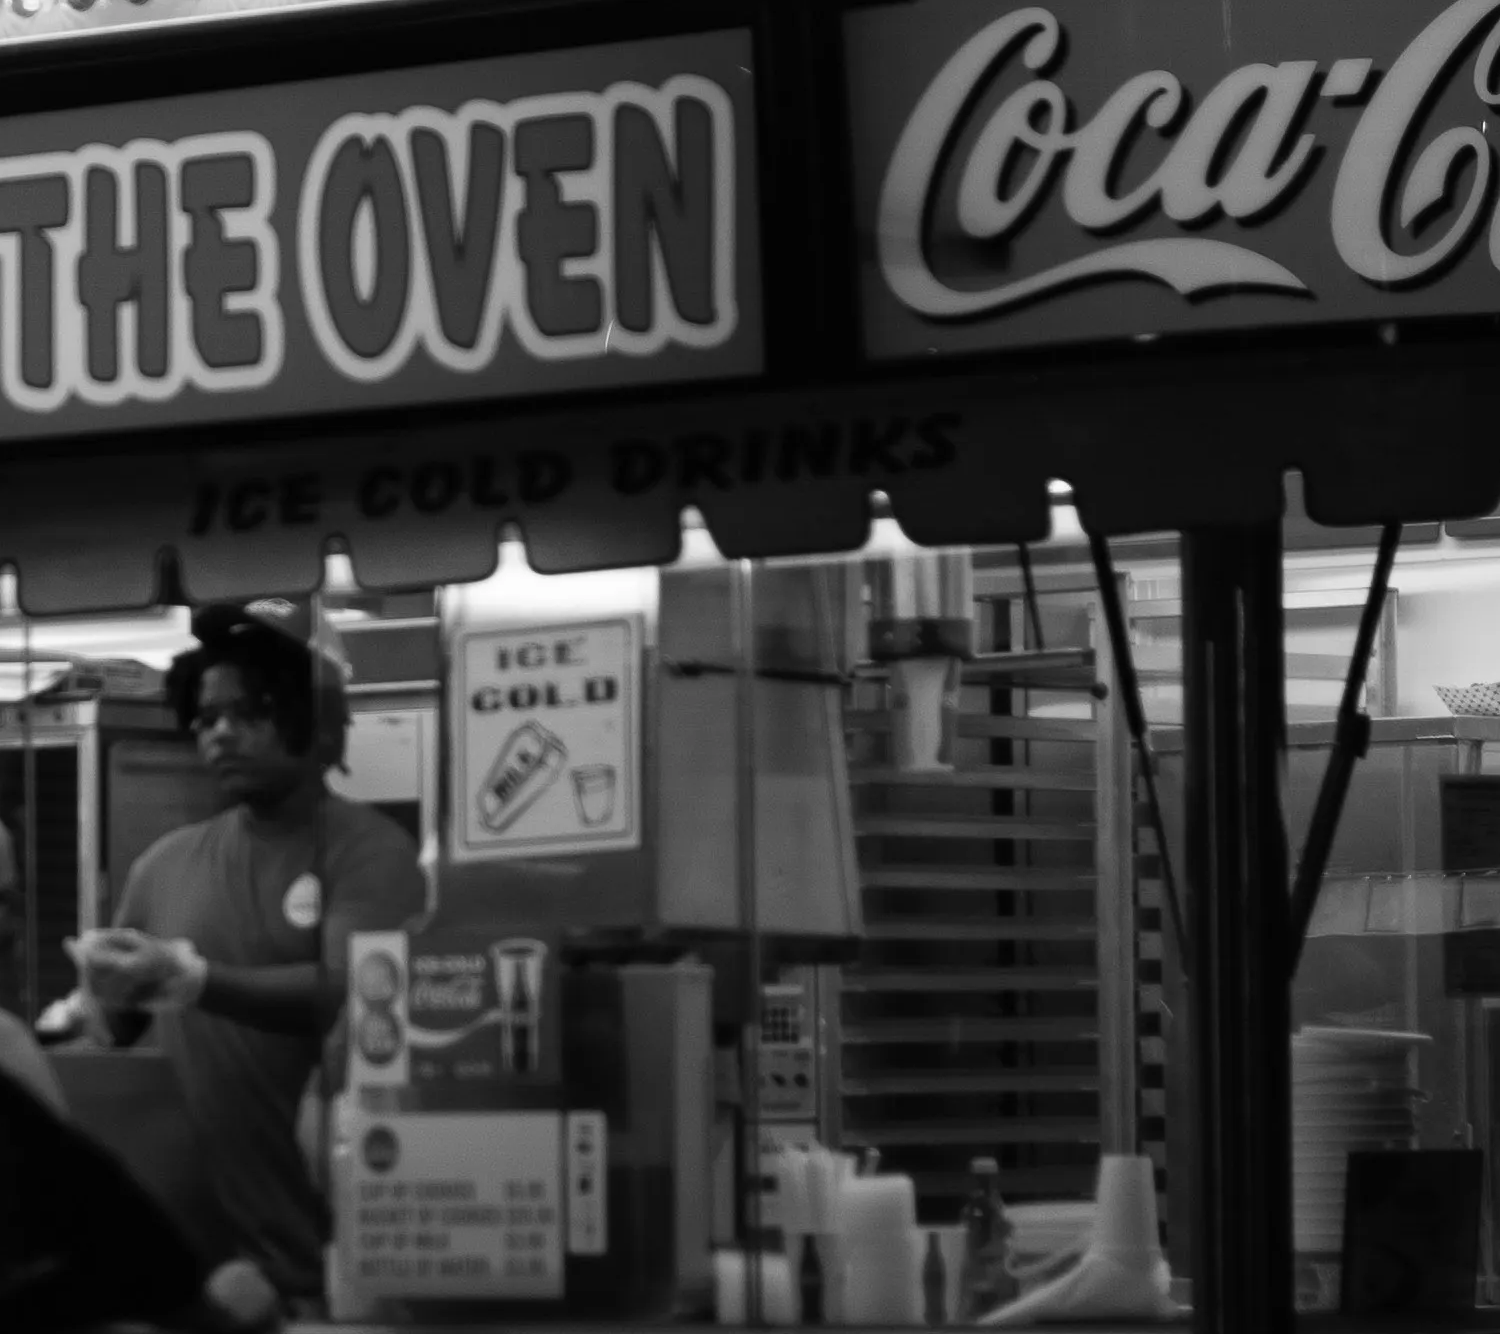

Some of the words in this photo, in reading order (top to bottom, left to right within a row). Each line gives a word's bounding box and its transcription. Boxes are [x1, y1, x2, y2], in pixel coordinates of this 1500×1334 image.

[298, 72, 740, 384] OVEN
[188, 472, 322, 536] ICE
[357, 450, 573, 518] COLD
[609, 411, 963, 496] DRINKS
[499, 635, 588, 670] ICE
[472, 676, 617, 711] COLD
